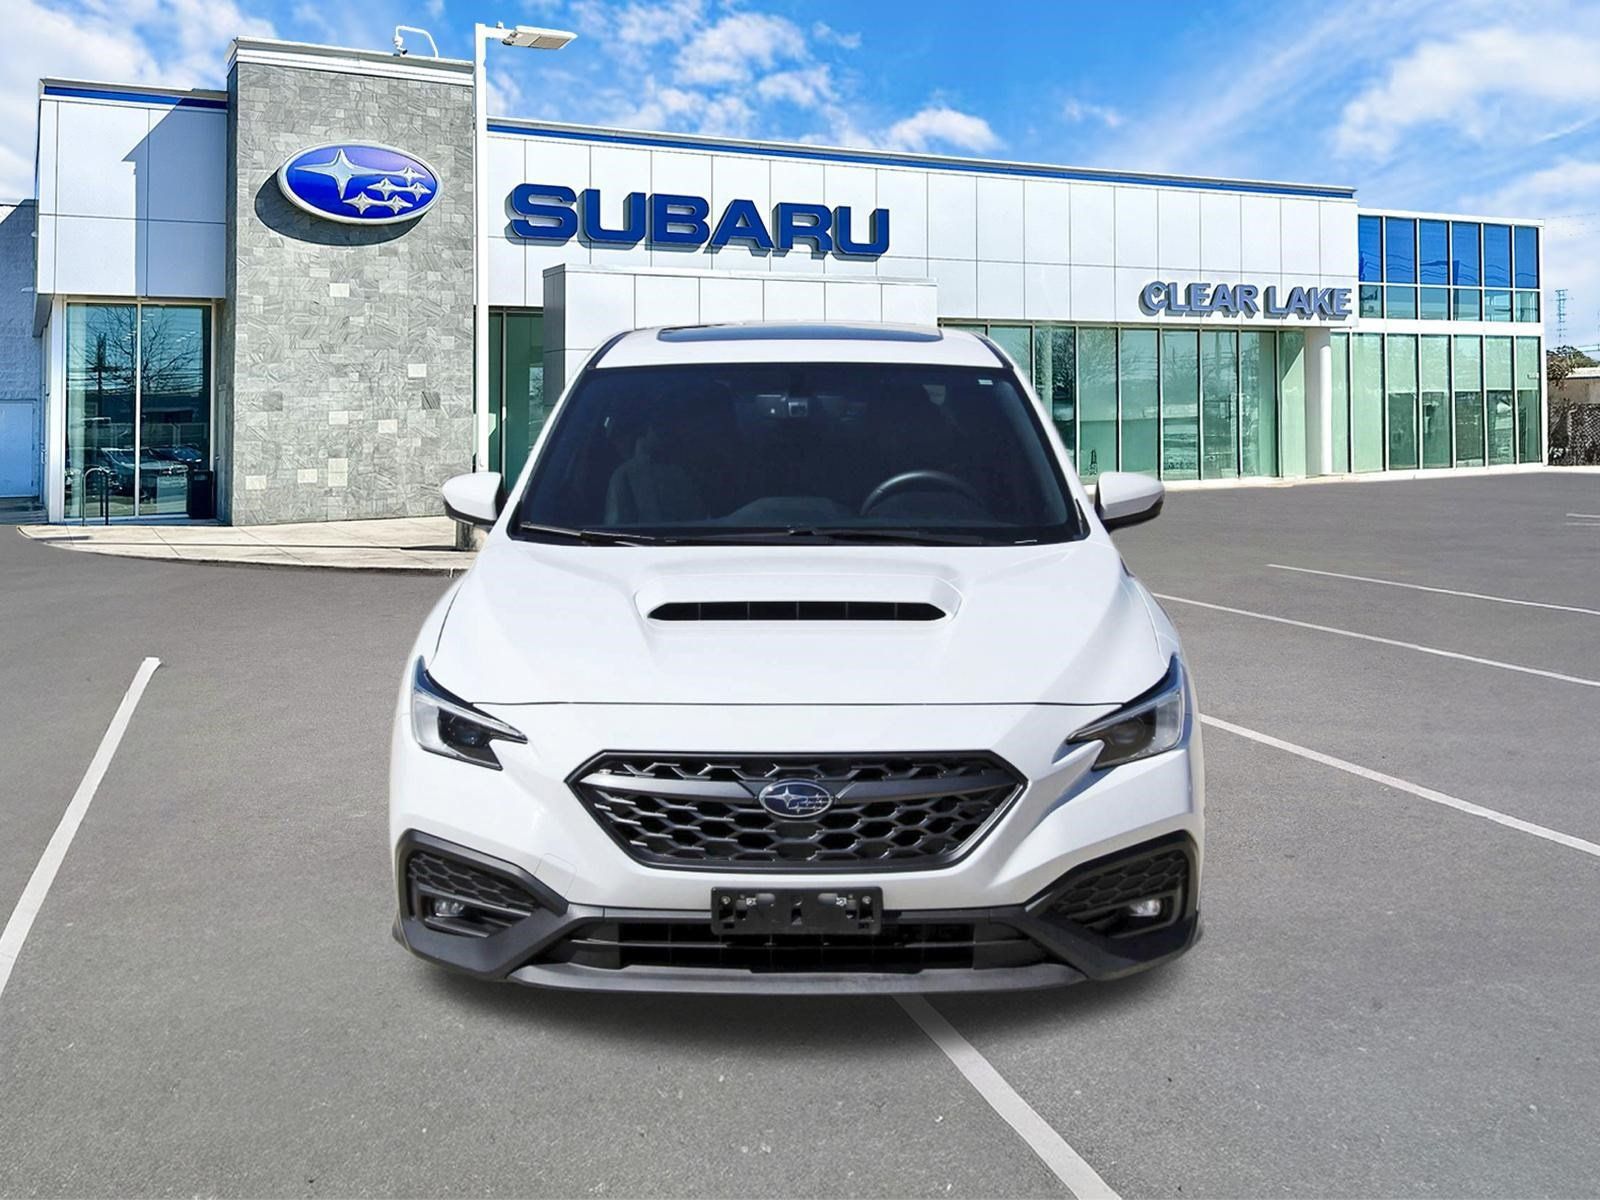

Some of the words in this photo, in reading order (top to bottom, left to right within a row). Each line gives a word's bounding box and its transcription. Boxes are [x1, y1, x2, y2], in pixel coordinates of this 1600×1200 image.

[509, 183, 889, 257] SUBARU
[1141, 281, 1260, 316] CLEAR
[1266, 286, 1352, 317] LAKE
